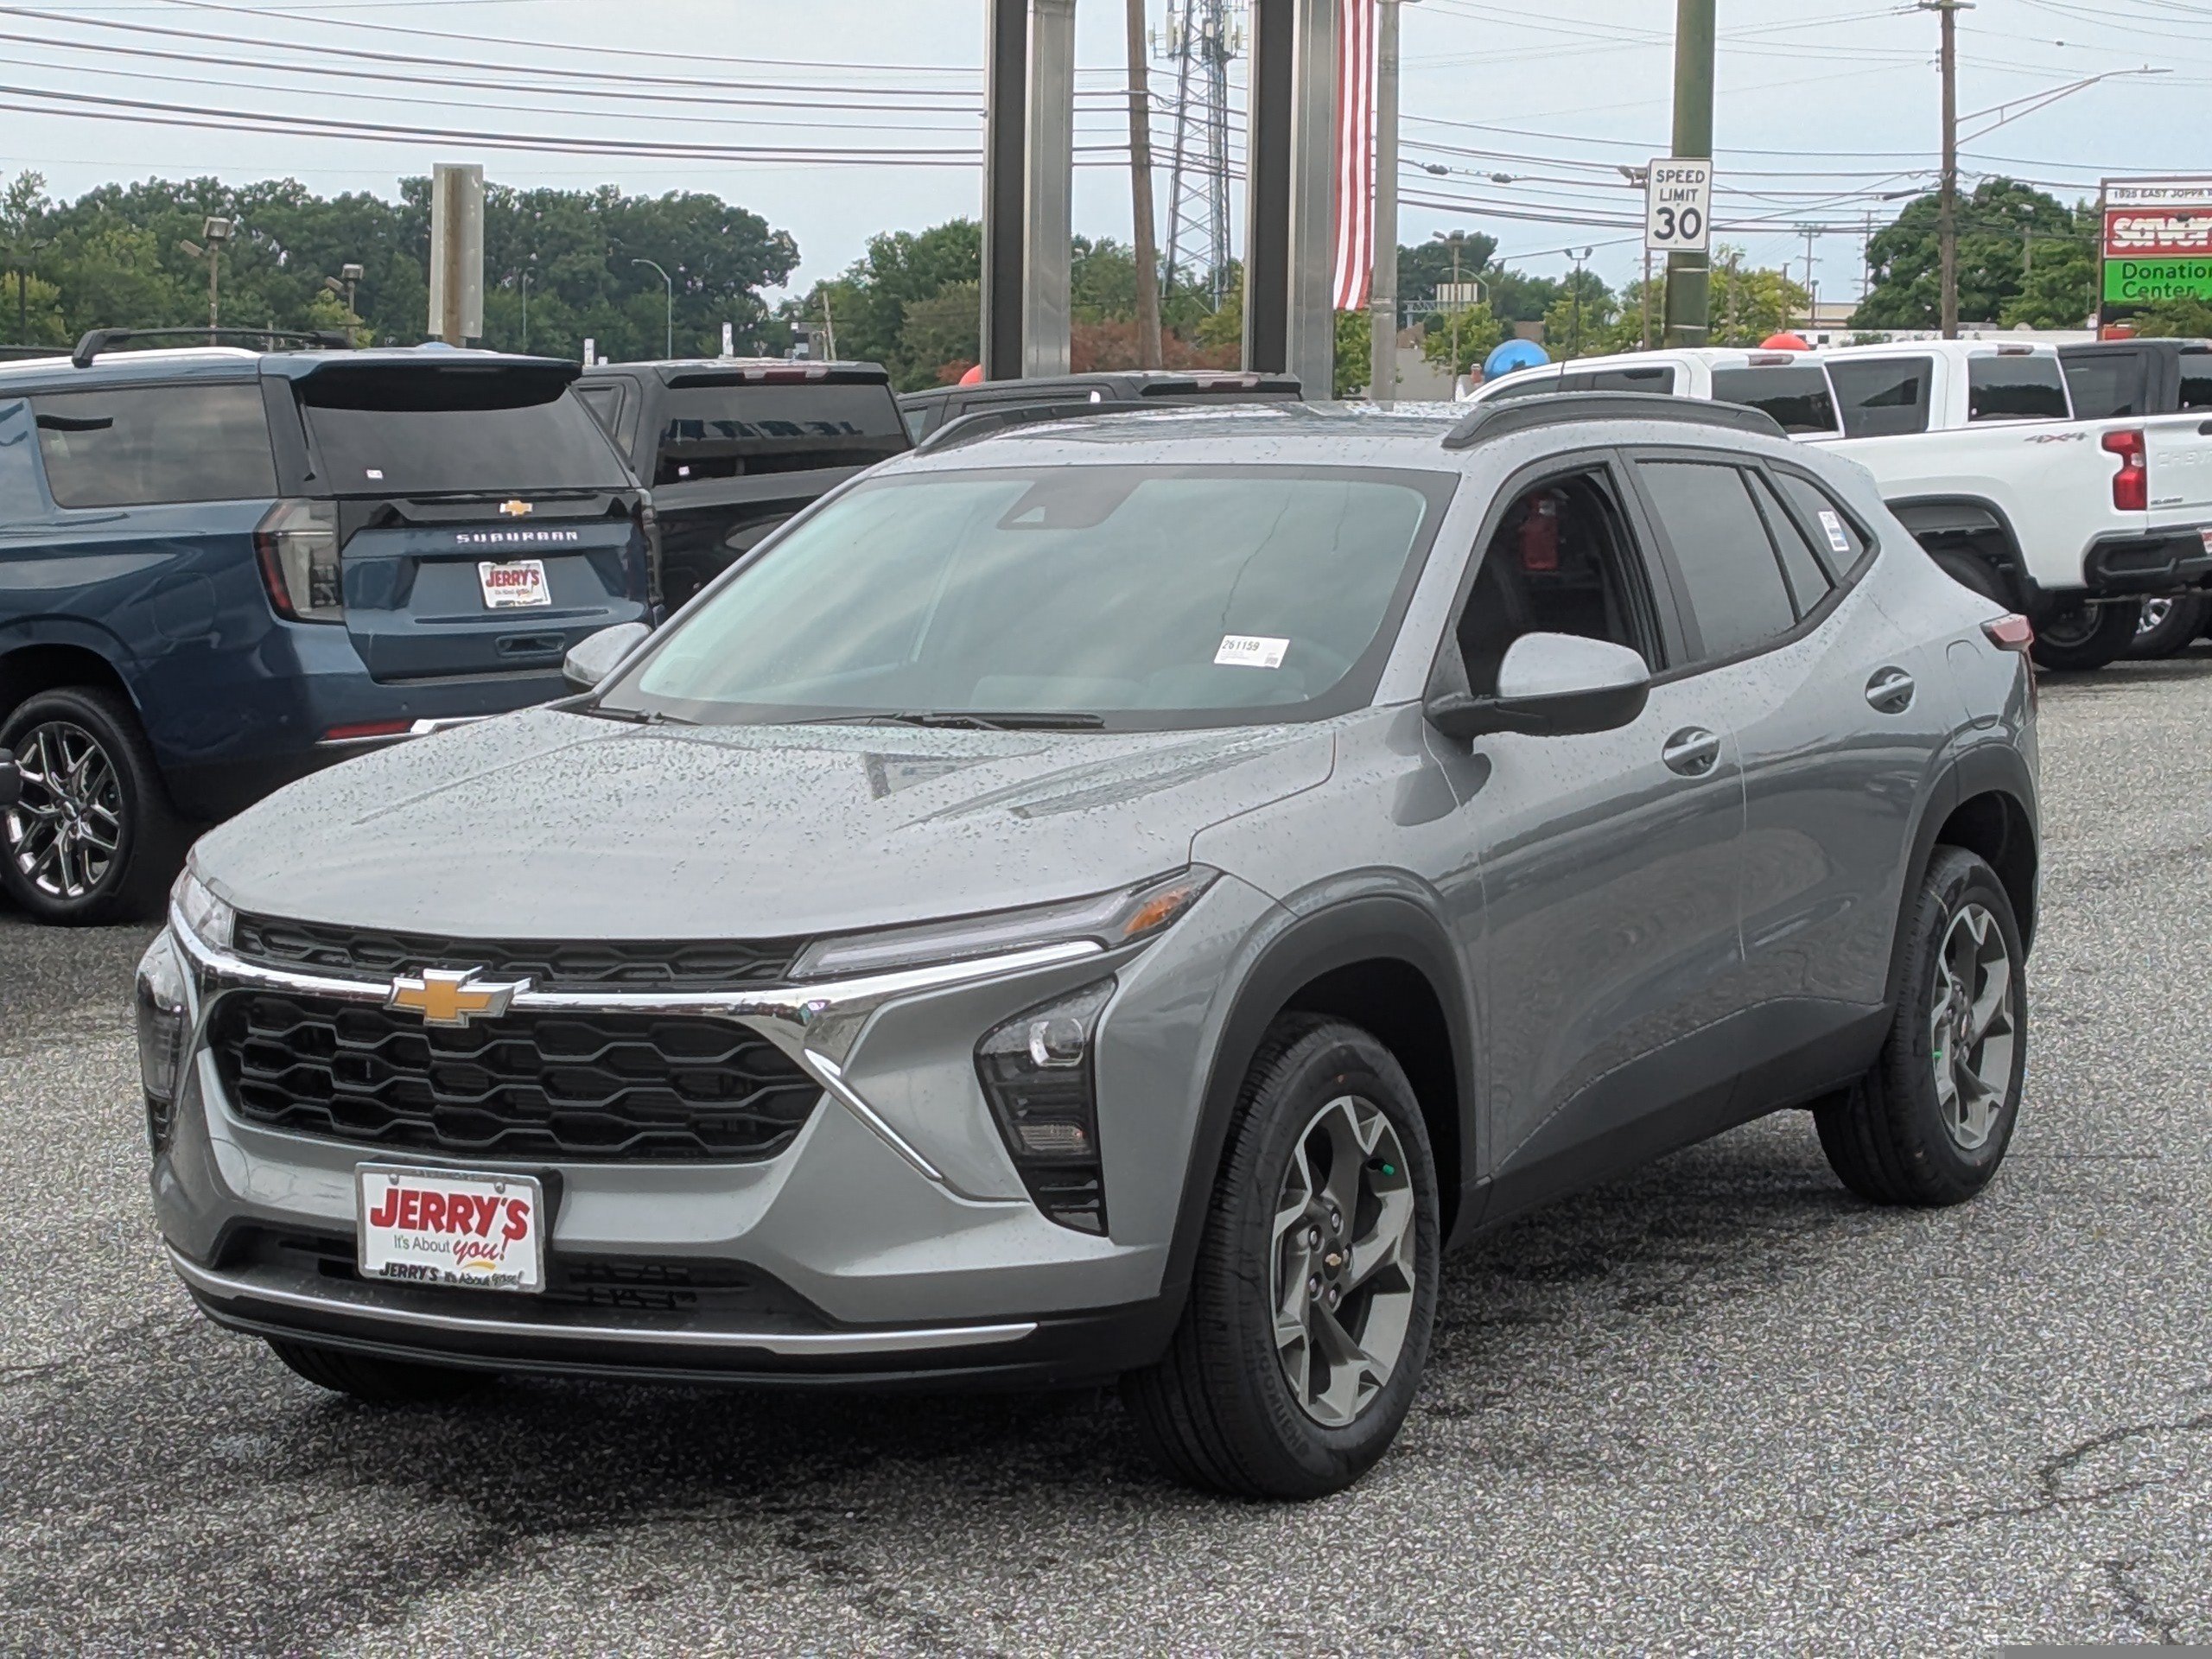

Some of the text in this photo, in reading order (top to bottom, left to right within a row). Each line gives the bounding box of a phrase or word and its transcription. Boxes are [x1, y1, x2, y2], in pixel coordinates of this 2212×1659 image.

[1656, 169, 1706, 183] SPEED
[1660, 188, 1698, 202] LIMIT
[1653, 207, 1702, 240] 30
[2122, 281, 2195, 298] Center
[456, 531, 579, 544] SUBURBAN
[486, 569, 540, 588] JERRY'S
[1222, 639, 1261, 652] 261159
[370, 1188, 531, 1241] JERRY'S
[394, 1235, 508, 1265] It's About you!
[378, 1262, 440, 1282] JERRY'S
